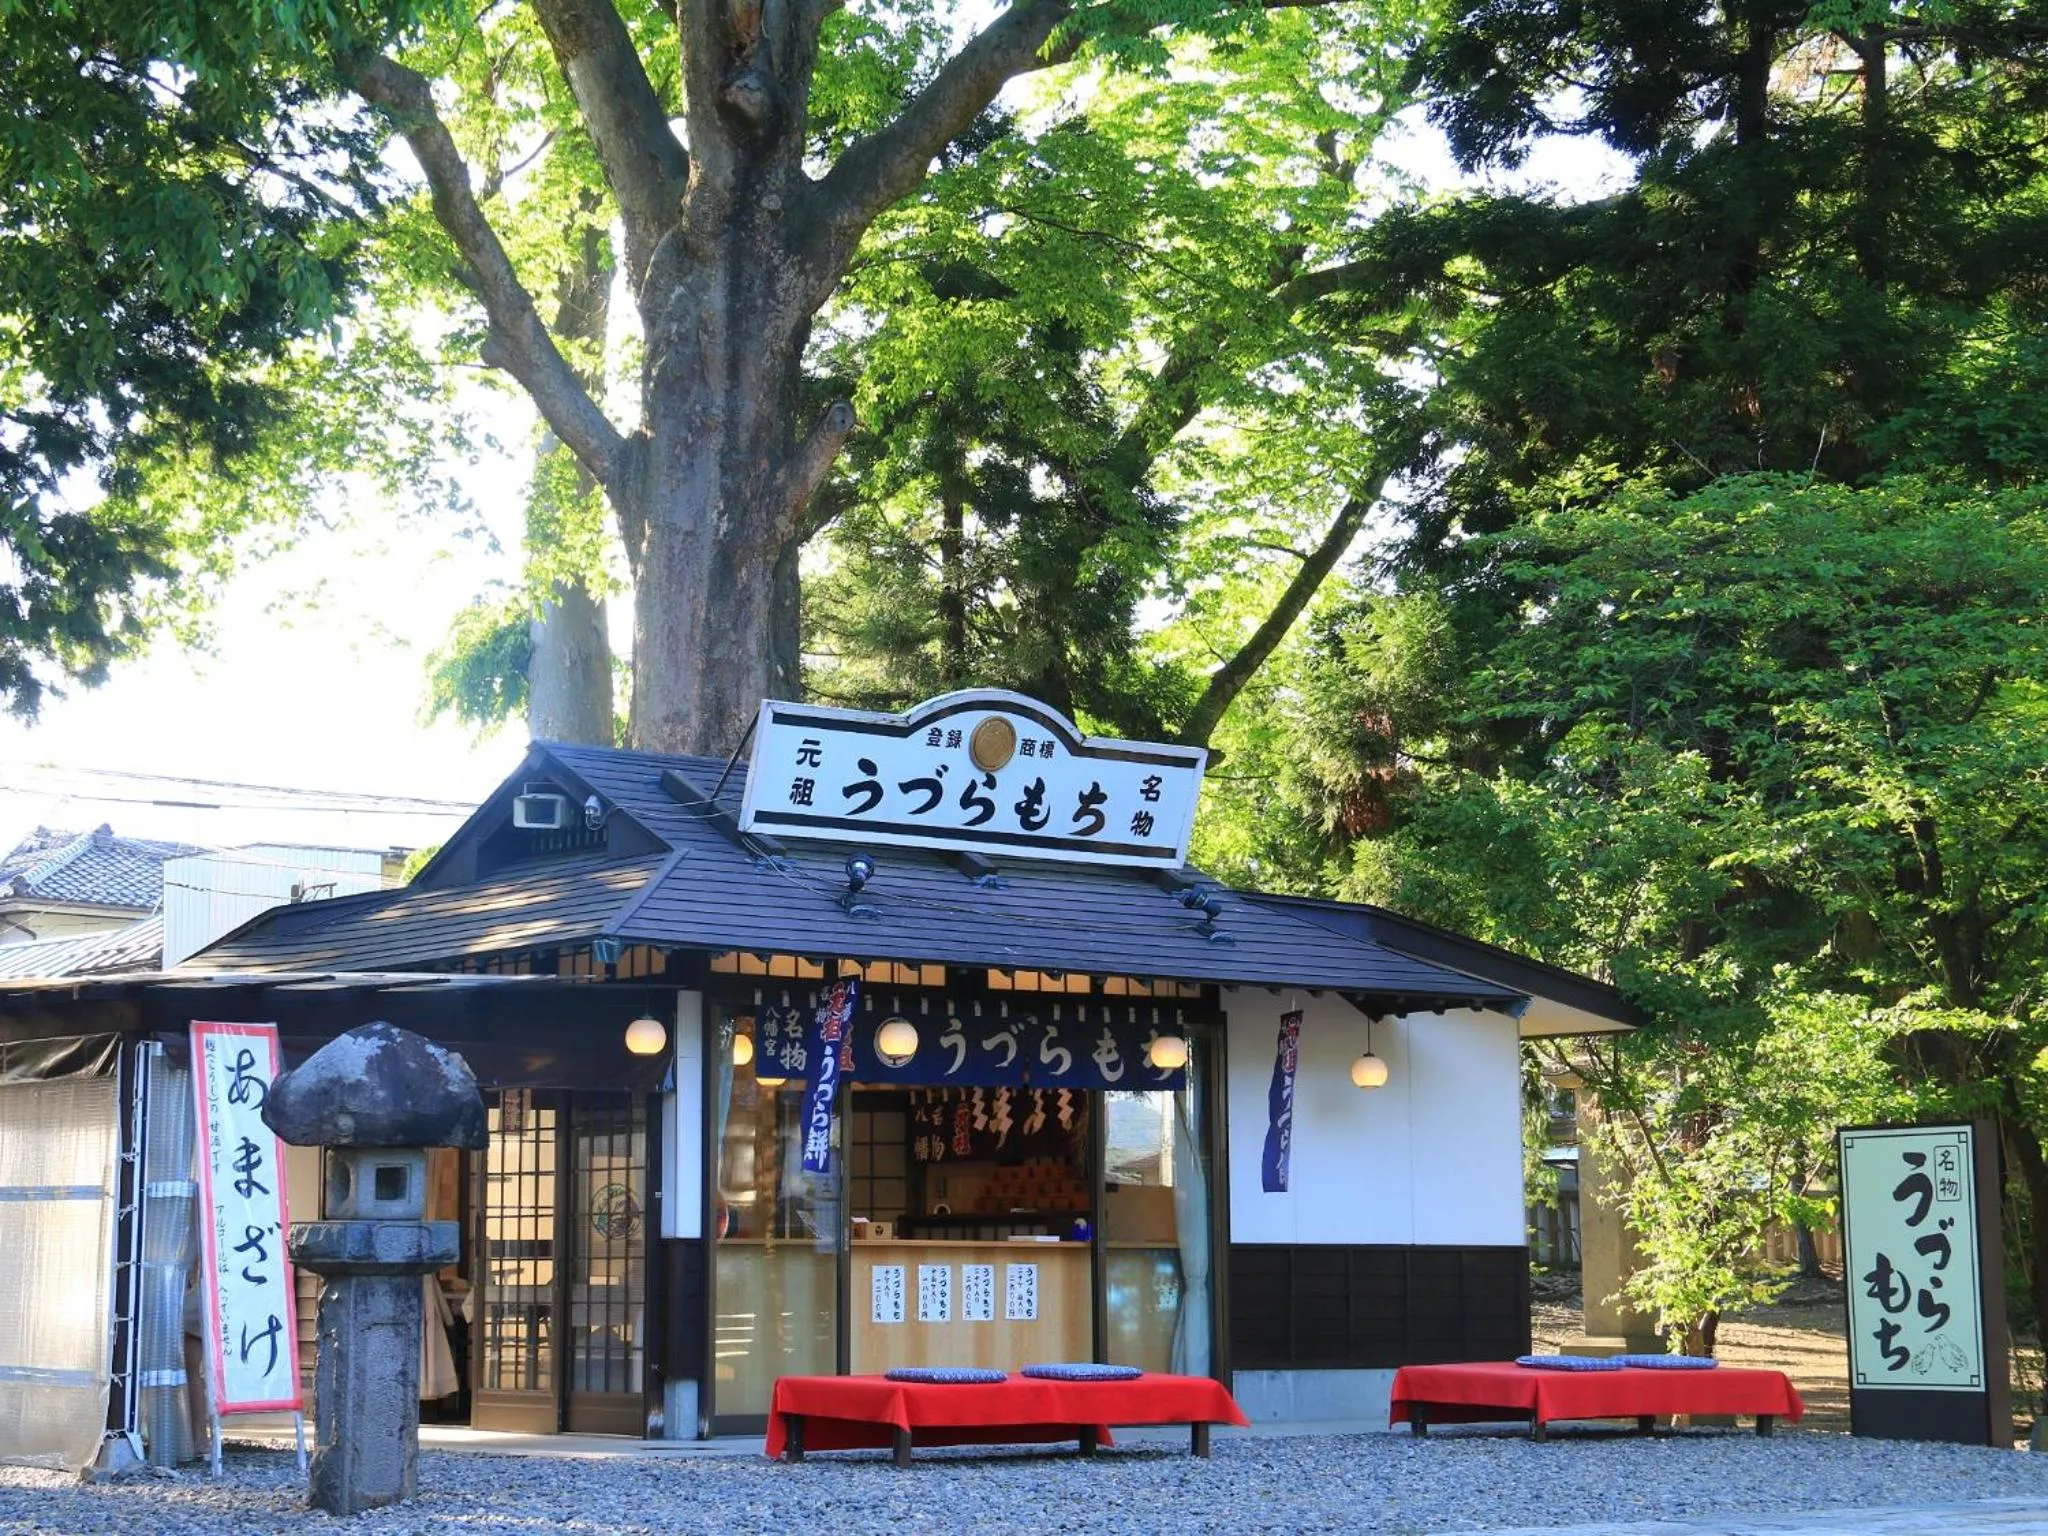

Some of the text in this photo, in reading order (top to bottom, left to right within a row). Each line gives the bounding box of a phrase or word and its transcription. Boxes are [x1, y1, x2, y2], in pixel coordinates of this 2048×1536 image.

[789, 738, 823, 807] 元祖
[926, 727, 1056, 760] 登録 商標
[842, 758, 1109, 836] うづらもち
[1130, 774, 1164, 838] 名物
[779, 1008, 808, 1071] 名物
[1938, 1149, 1959, 1198] 名物
[224, 1048, 283, 1378] あまざけ
[1892, 1151, 1955, 1333] うづら
[893, 1268, 901, 1320] うづらもち
[939, 1267, 947, 1319] うづらもち
[982, 1267, 990, 1318] うづらもち
[1025, 1267, 1034, 1317] うづらもち
[1862, 1252, 1912, 1371] もち
